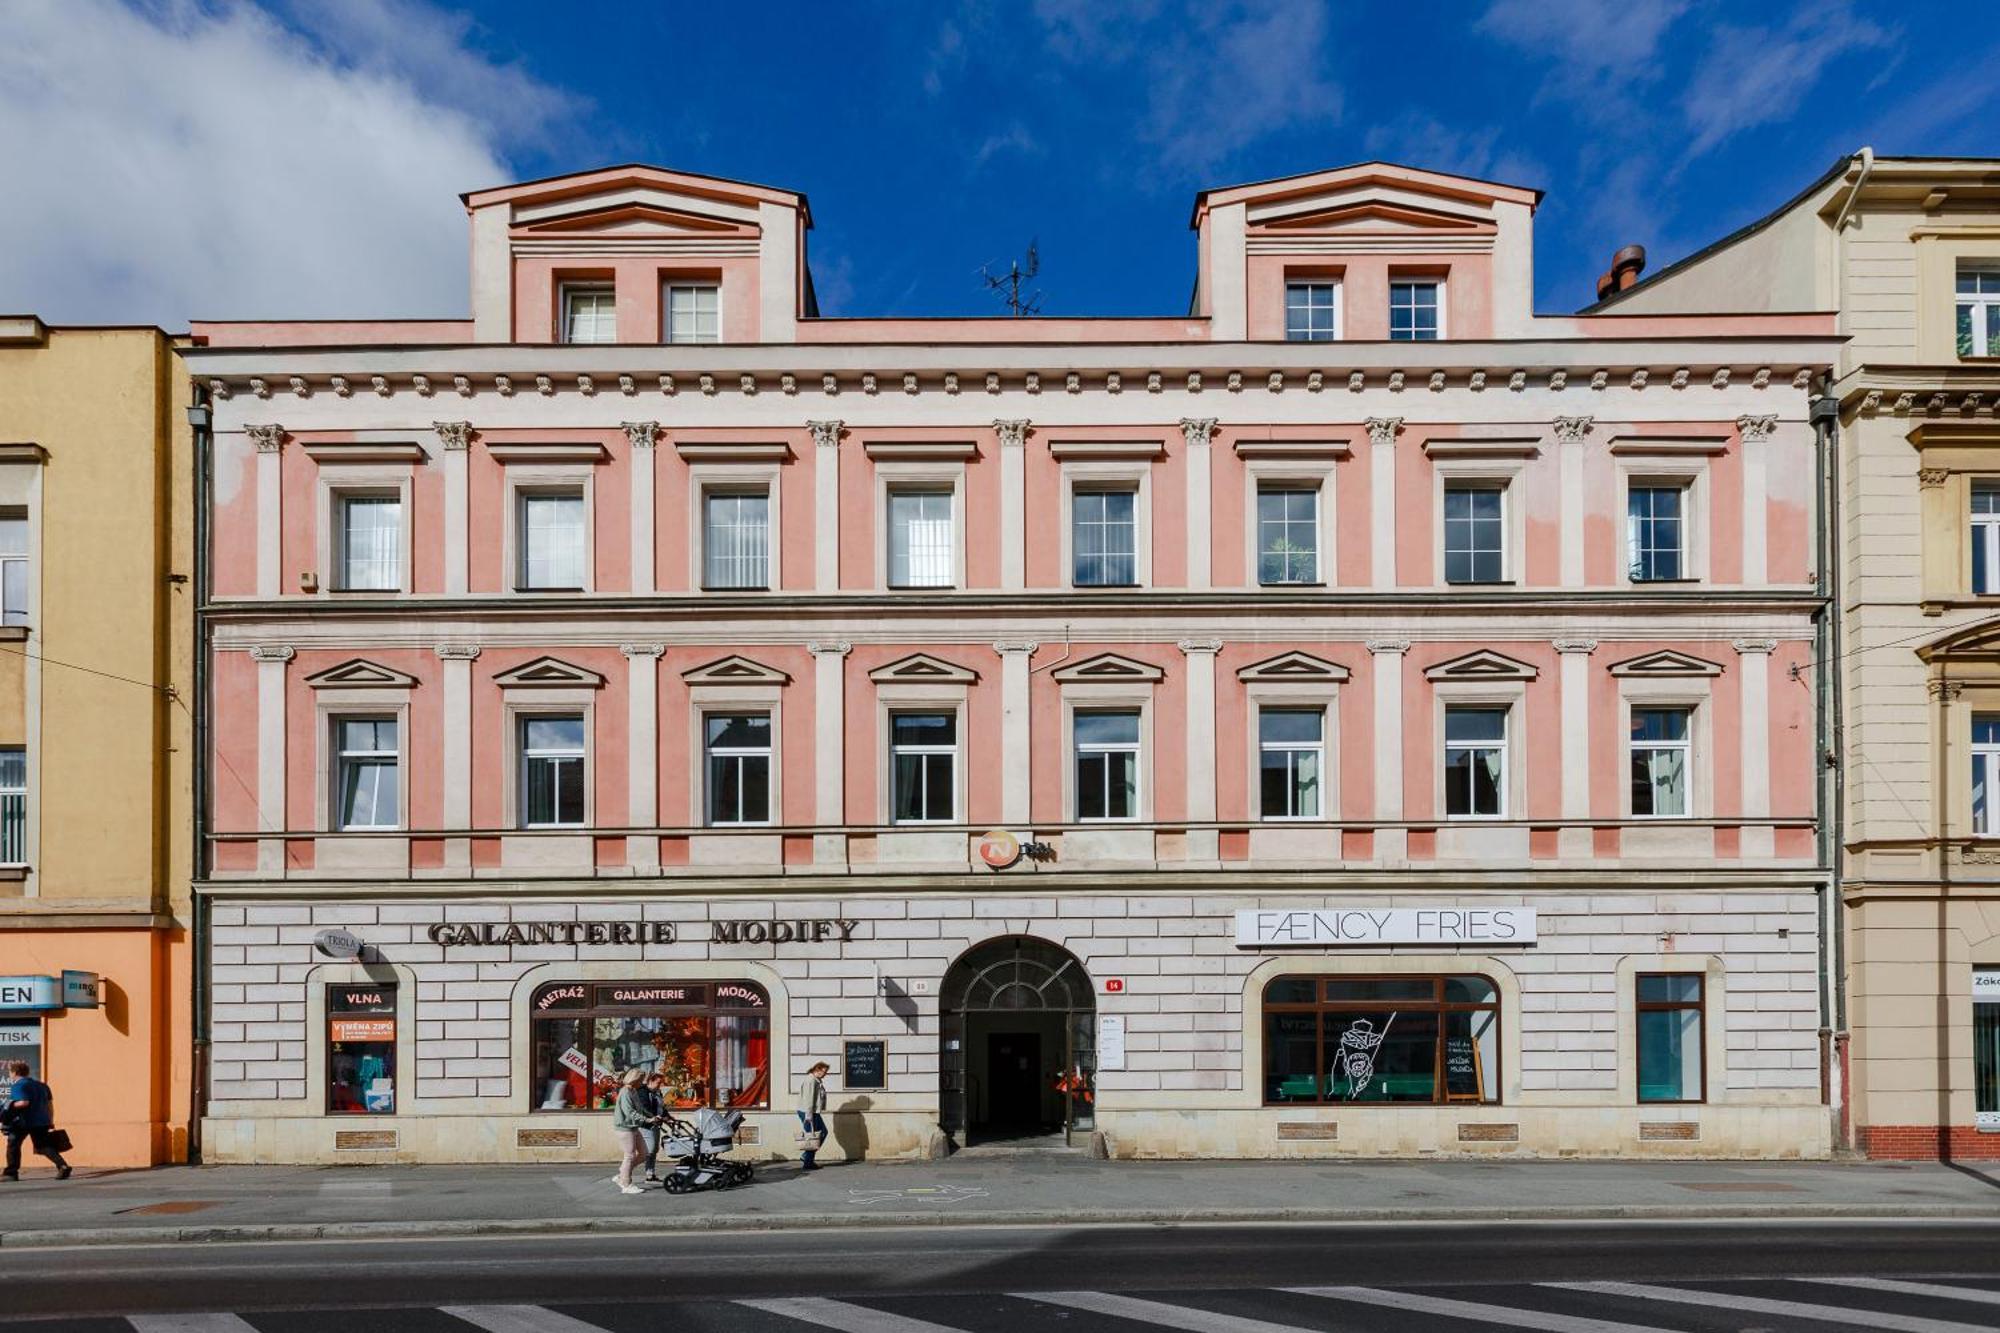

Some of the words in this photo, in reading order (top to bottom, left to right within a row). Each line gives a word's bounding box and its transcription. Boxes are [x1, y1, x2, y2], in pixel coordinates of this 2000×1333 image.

[428, 922, 677, 946] GALANTERIE
[712, 919, 859, 944] MODIFY
[1417, 911, 1516, 939] FRIES
[346, 994, 382, 1004] VLNA
[538, 986, 585, 1010] METRÁŽ
[614, 988, 686, 1001] GALANTERIE
[717, 986, 764, 1007] MODIFY
